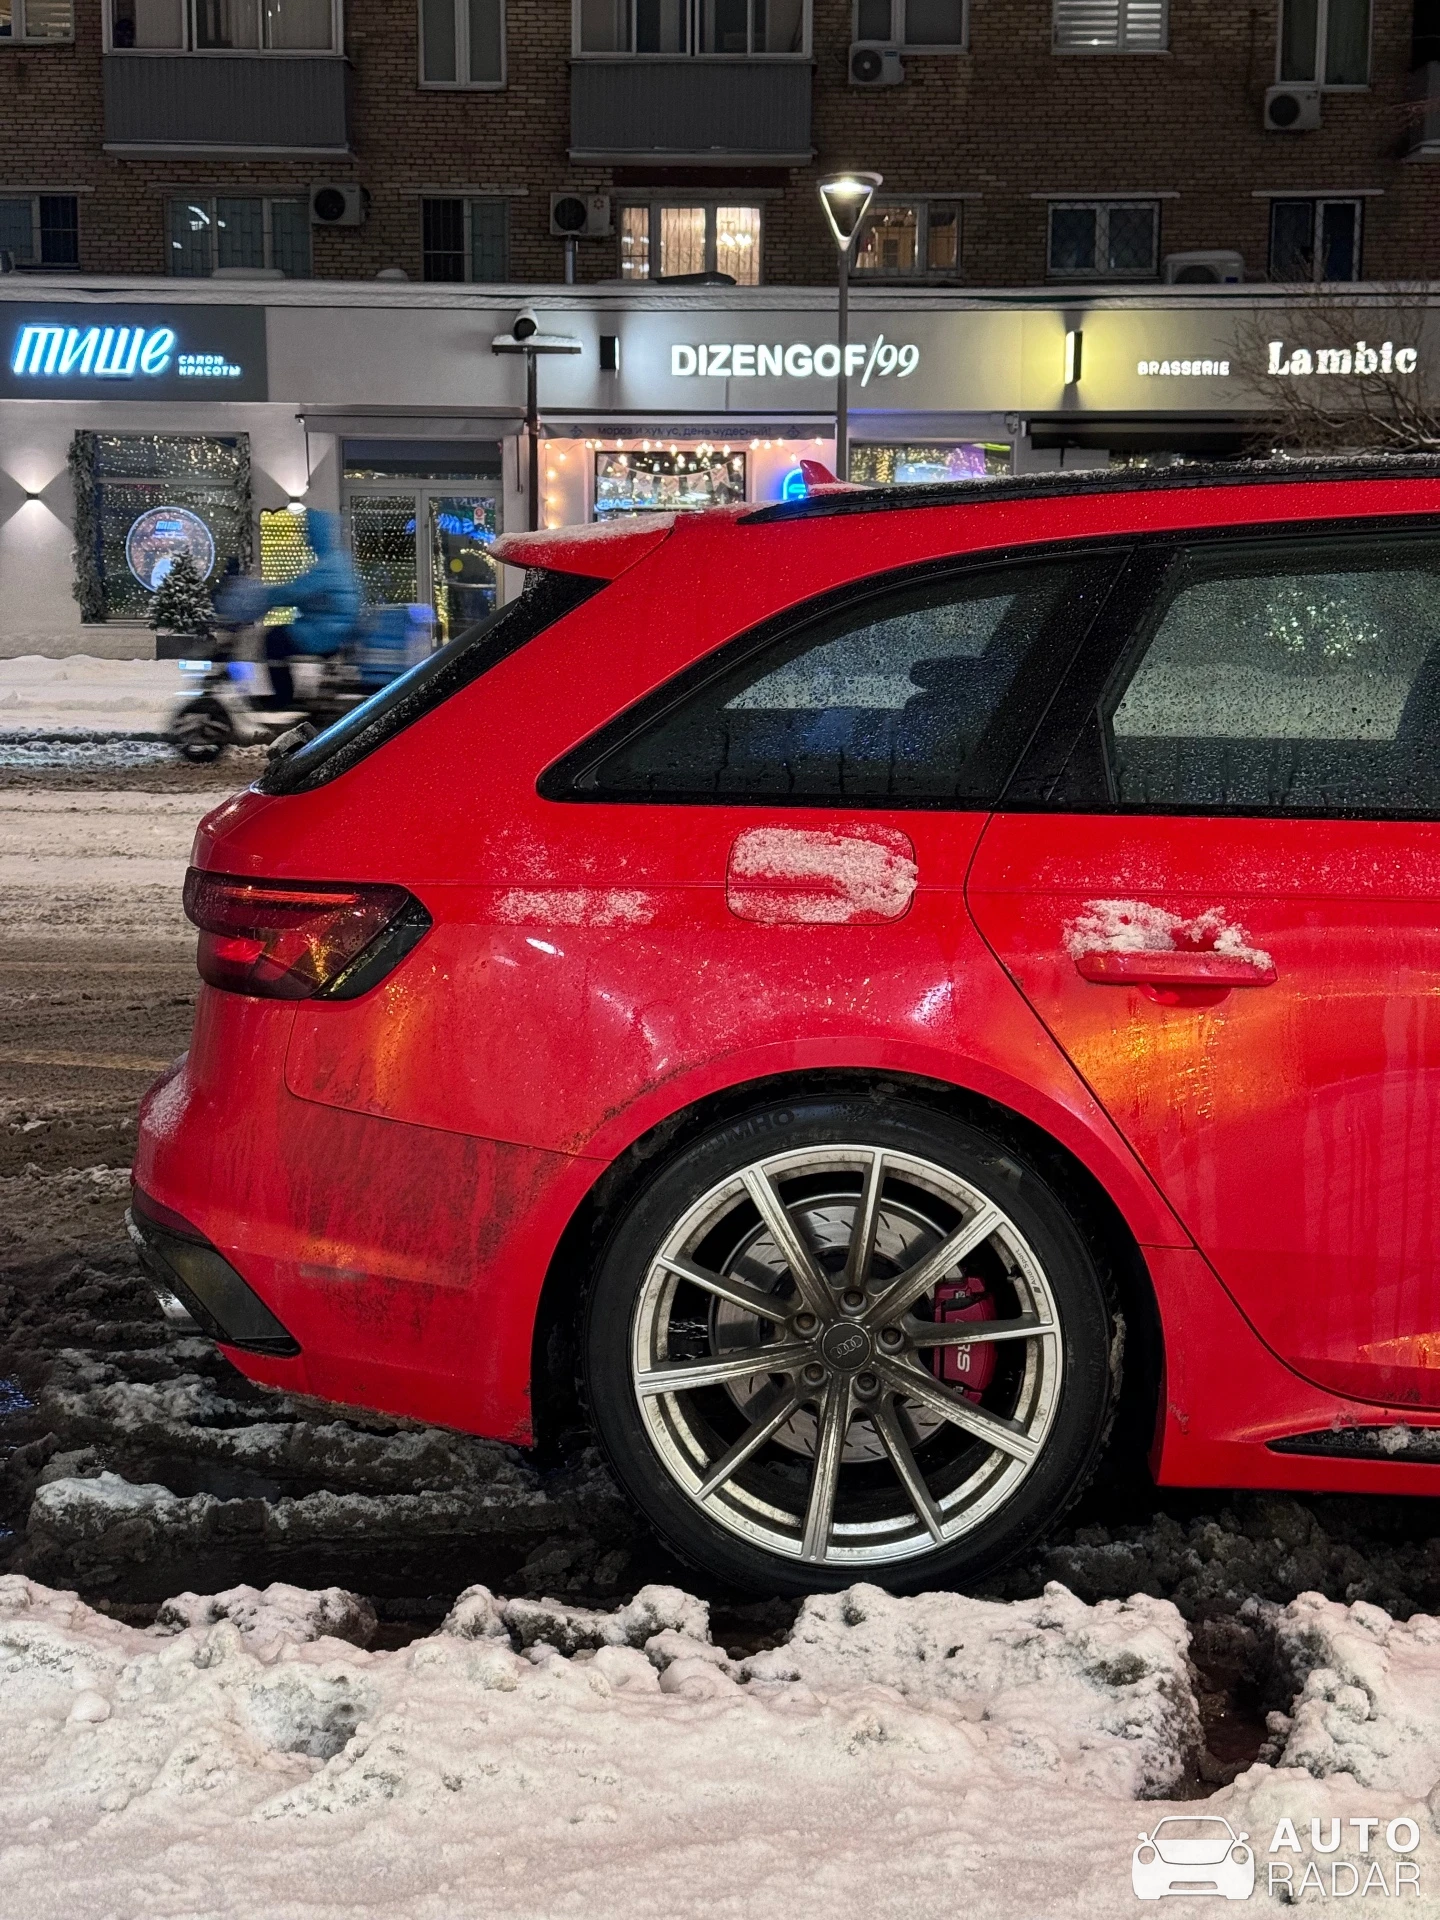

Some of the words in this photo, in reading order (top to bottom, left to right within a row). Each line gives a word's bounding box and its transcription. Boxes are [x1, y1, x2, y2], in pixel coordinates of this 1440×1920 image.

[178, 354, 224, 365] САЛОН
[1267, 341, 1418, 376] Lambic
[178, 365, 241, 377] КРАСОТЫ
[1137, 360, 1230, 376] BRASSERIE
